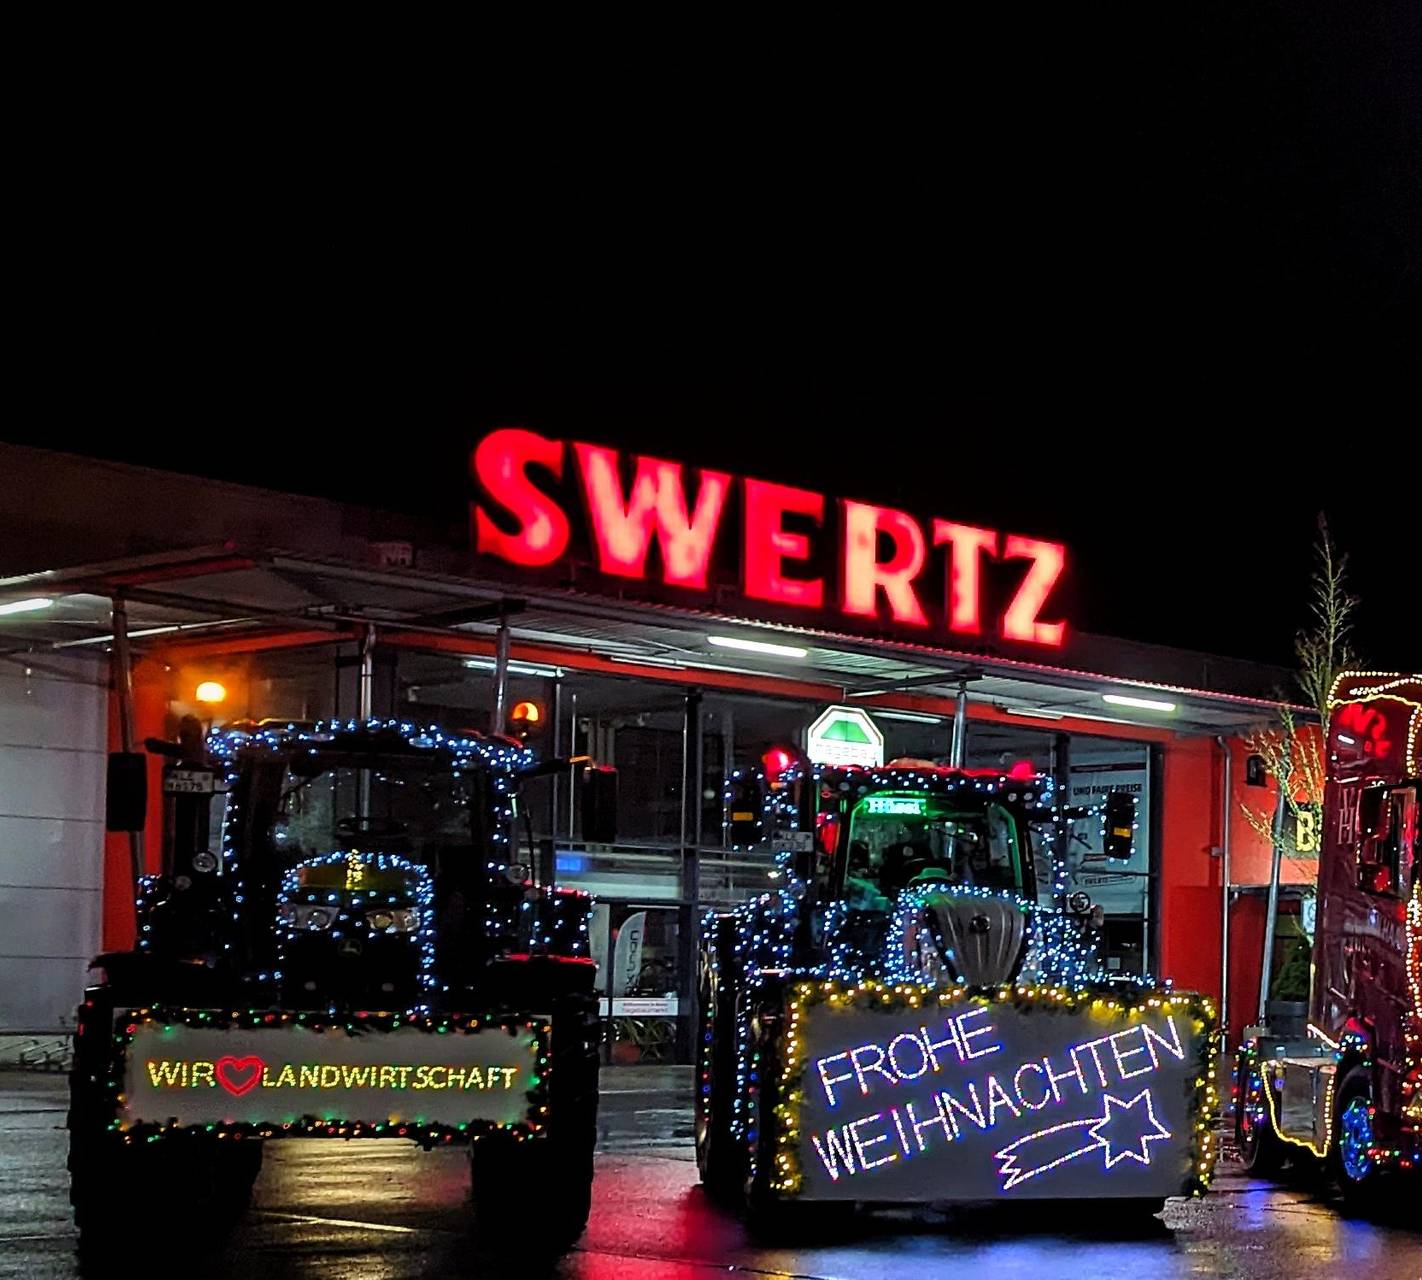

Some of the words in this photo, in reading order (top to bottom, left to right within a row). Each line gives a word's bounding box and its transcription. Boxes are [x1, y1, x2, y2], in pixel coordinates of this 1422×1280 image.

[473, 428, 1068, 647] SWERTZ
[147, 1061, 216, 1088] WIR
[262, 1065, 518, 1089] LANDWIRTSCHAFT
[812, 1015, 1185, 1181] WEIHNACHTEN
[816, 1006, 1001, 1107] FROHE
